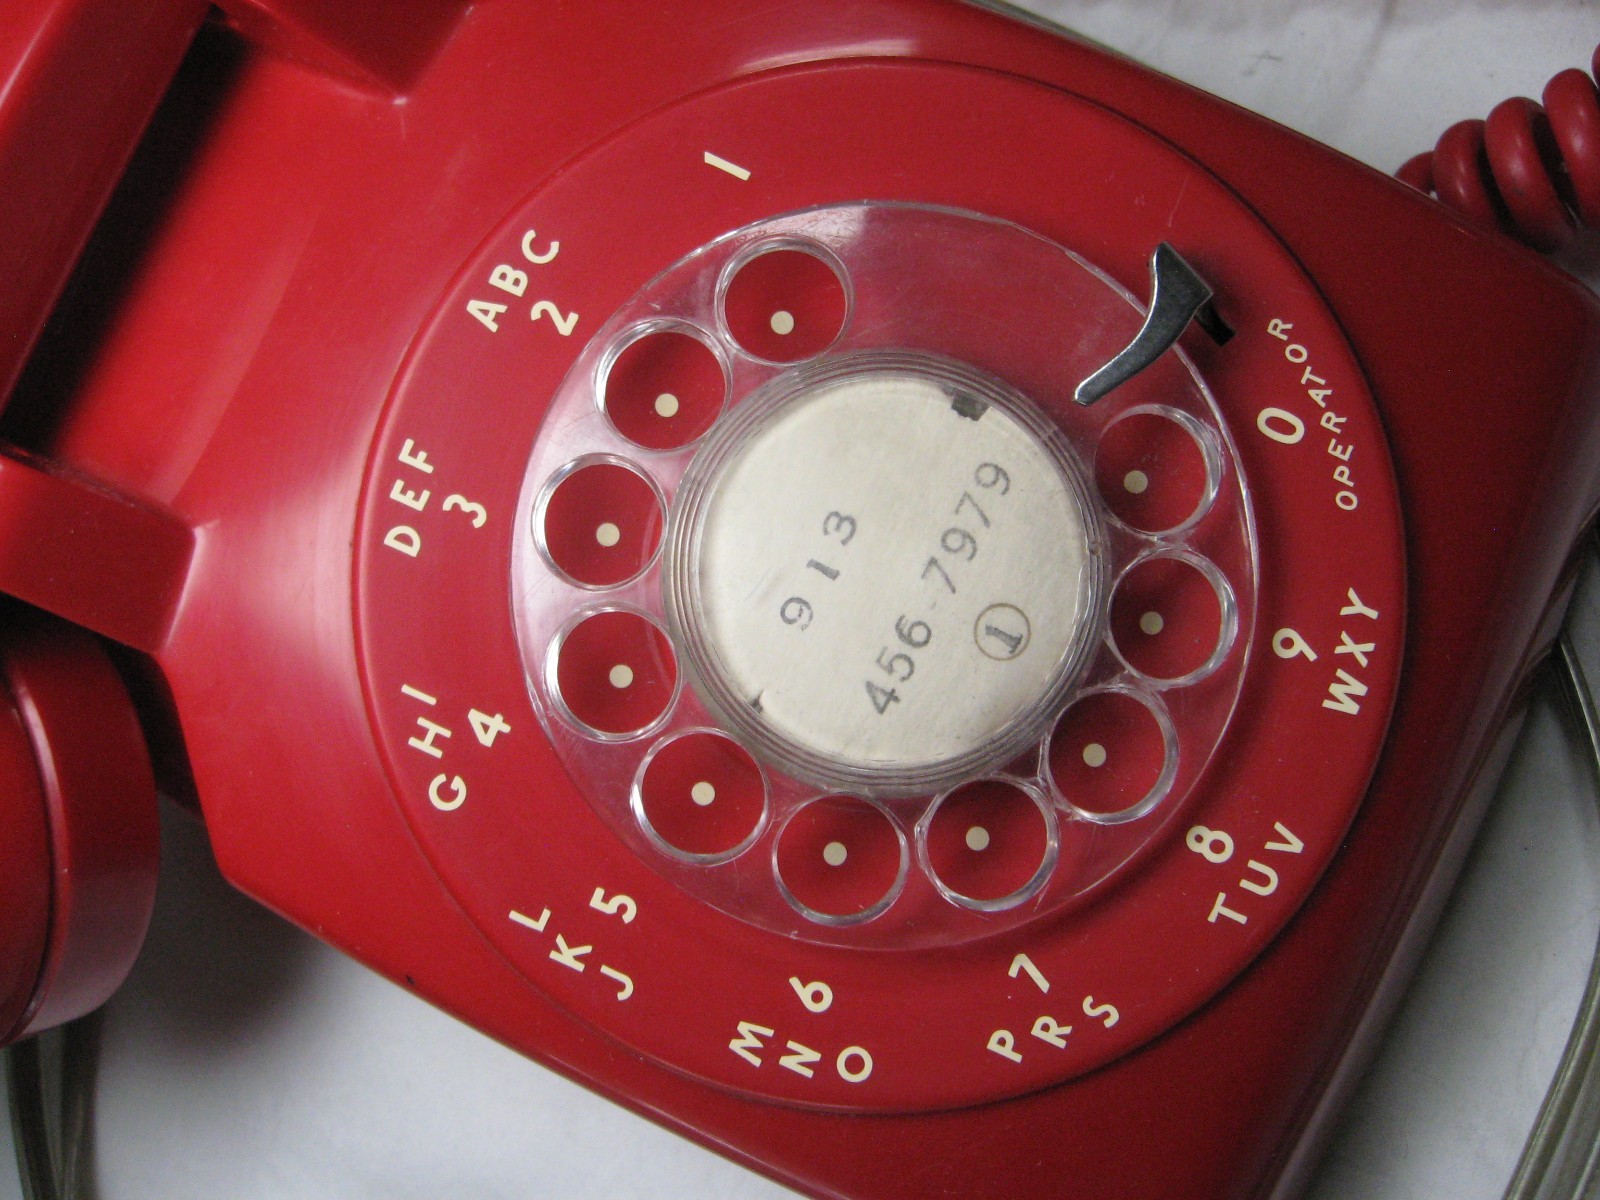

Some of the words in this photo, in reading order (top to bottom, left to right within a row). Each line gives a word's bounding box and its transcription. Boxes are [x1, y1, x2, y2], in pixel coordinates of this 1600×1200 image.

[703, 150, 752, 181] 1
[465, 228, 561, 335] ABC
[529, 299, 580, 337] 2
[1256, 407, 1306, 445] 0
[1266, 318, 1358, 511] OPERATOR
[383, 438, 435, 558] DEF
[441, 492, 488, 529] 3
[779, 510, 858, 633] 913
[865, 461, 1012, 716] 456-7979
[1272, 627, 1318, 662] 9
[1321, 587, 1379, 716] WXY
[400, 684, 468, 812] GHI
[467, 707, 512, 748] 4
[1186, 826, 1235, 864] 8
[1207, 821, 1305, 925] TUV
[588, 886, 638, 925] 5
[508, 906, 634, 1002] JKL
[1007, 953, 1050, 994] 7
[788, 976, 834, 1013] 6
[728, 1020, 874, 1083] MNO
[986, 995, 1120, 1063] PRS
